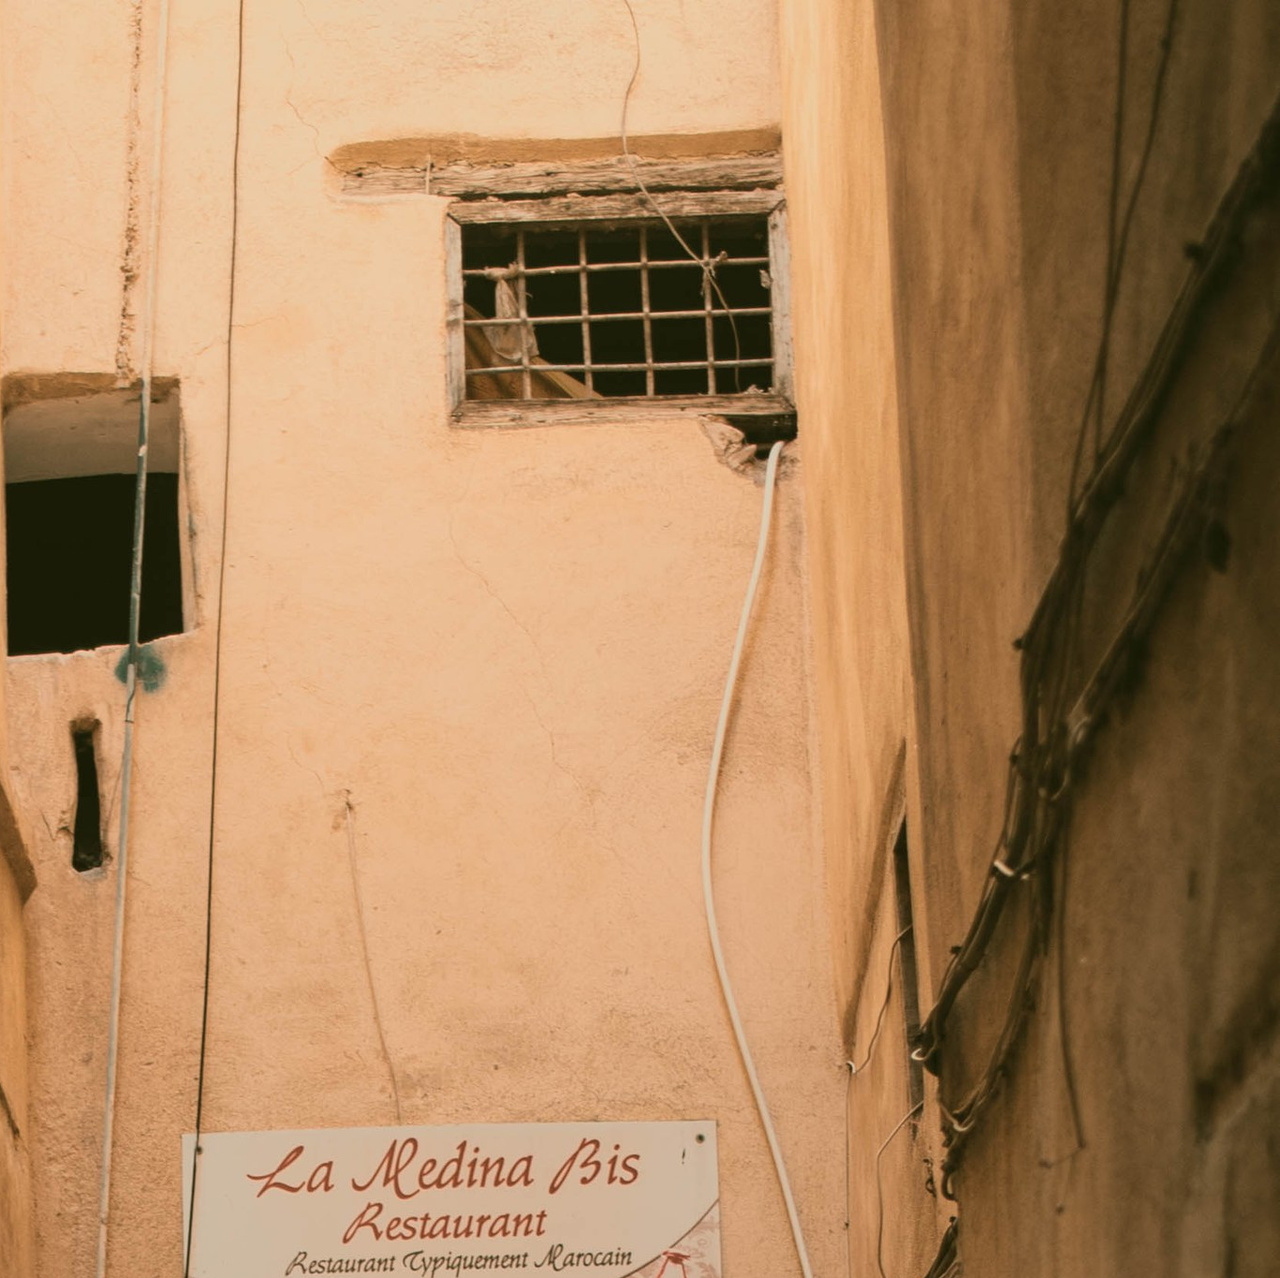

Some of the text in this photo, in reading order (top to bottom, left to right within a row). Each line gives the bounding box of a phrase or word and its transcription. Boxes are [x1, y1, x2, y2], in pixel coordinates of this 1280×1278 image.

[247, 1137, 641, 1199] La Medina Bis
[342, 1202, 548, 1244] Restaurant
[285, 1243, 633, 1278] Restaurant Typiquement Marocain
